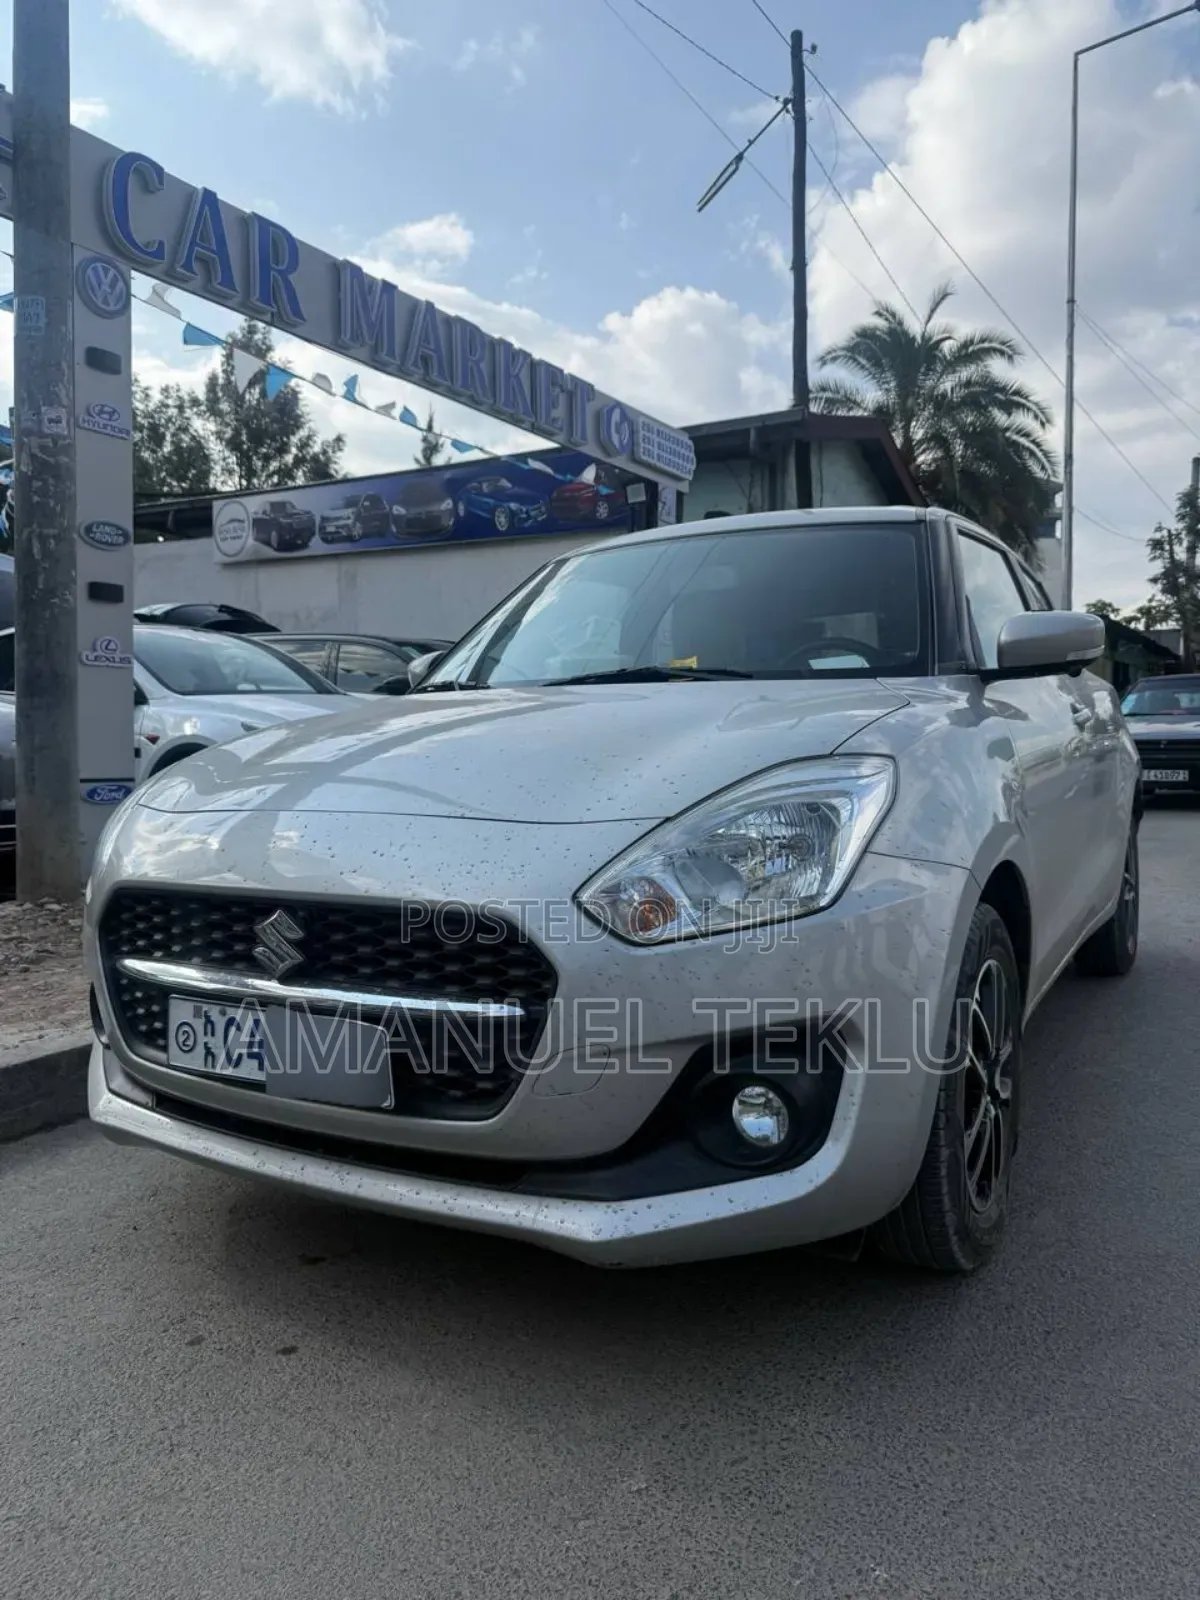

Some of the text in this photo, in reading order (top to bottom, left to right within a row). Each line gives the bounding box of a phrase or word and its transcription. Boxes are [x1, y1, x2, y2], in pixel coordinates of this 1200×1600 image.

[103, 151, 595, 446] CAR MARKET
[81, 416, 131, 437] HYUNDAI
[84, 654, 132, 665] LEXUS
[93, 785, 126, 801] Ford
